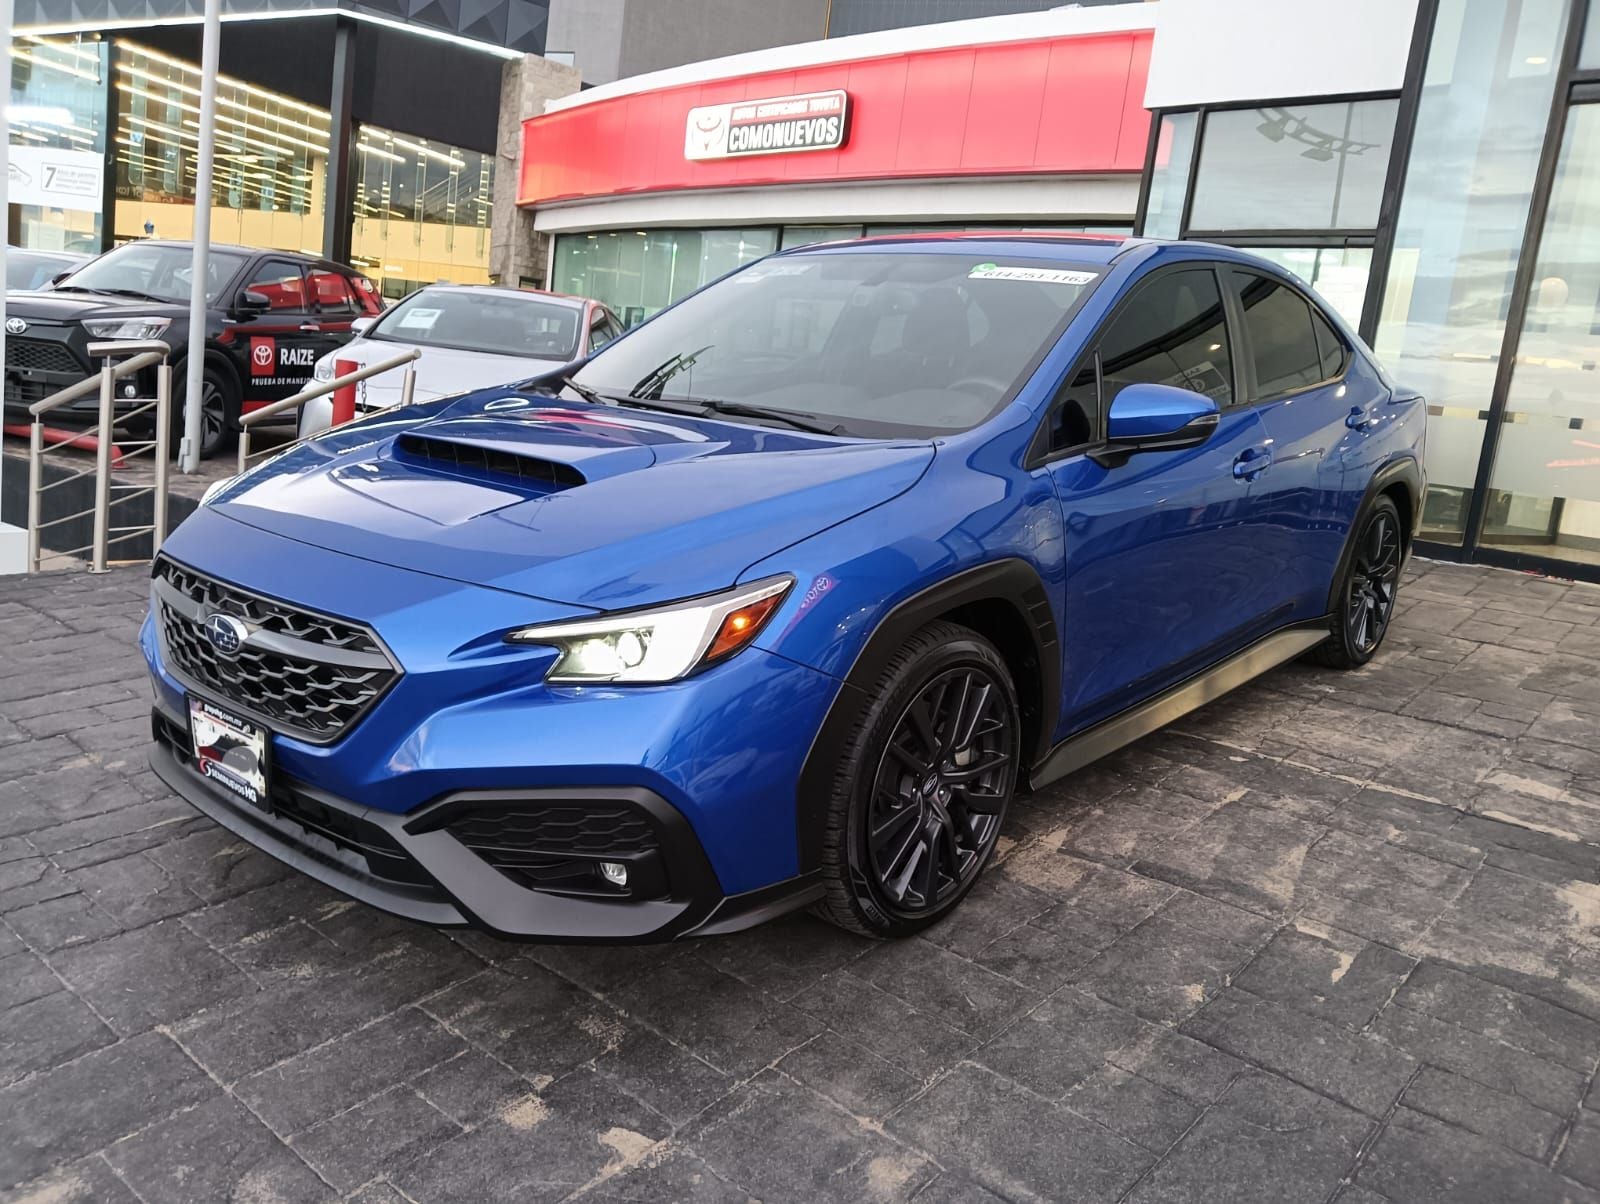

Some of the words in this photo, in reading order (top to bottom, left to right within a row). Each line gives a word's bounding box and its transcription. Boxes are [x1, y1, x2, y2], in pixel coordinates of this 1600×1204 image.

[729, 117, 839, 151] COMONUEVOS
[46, 167, 57, 188] 7
[280, 348, 314, 365] RAIZE
[251, 377, 276, 386] PRUEBA
[277, 377, 285, 385] DE
